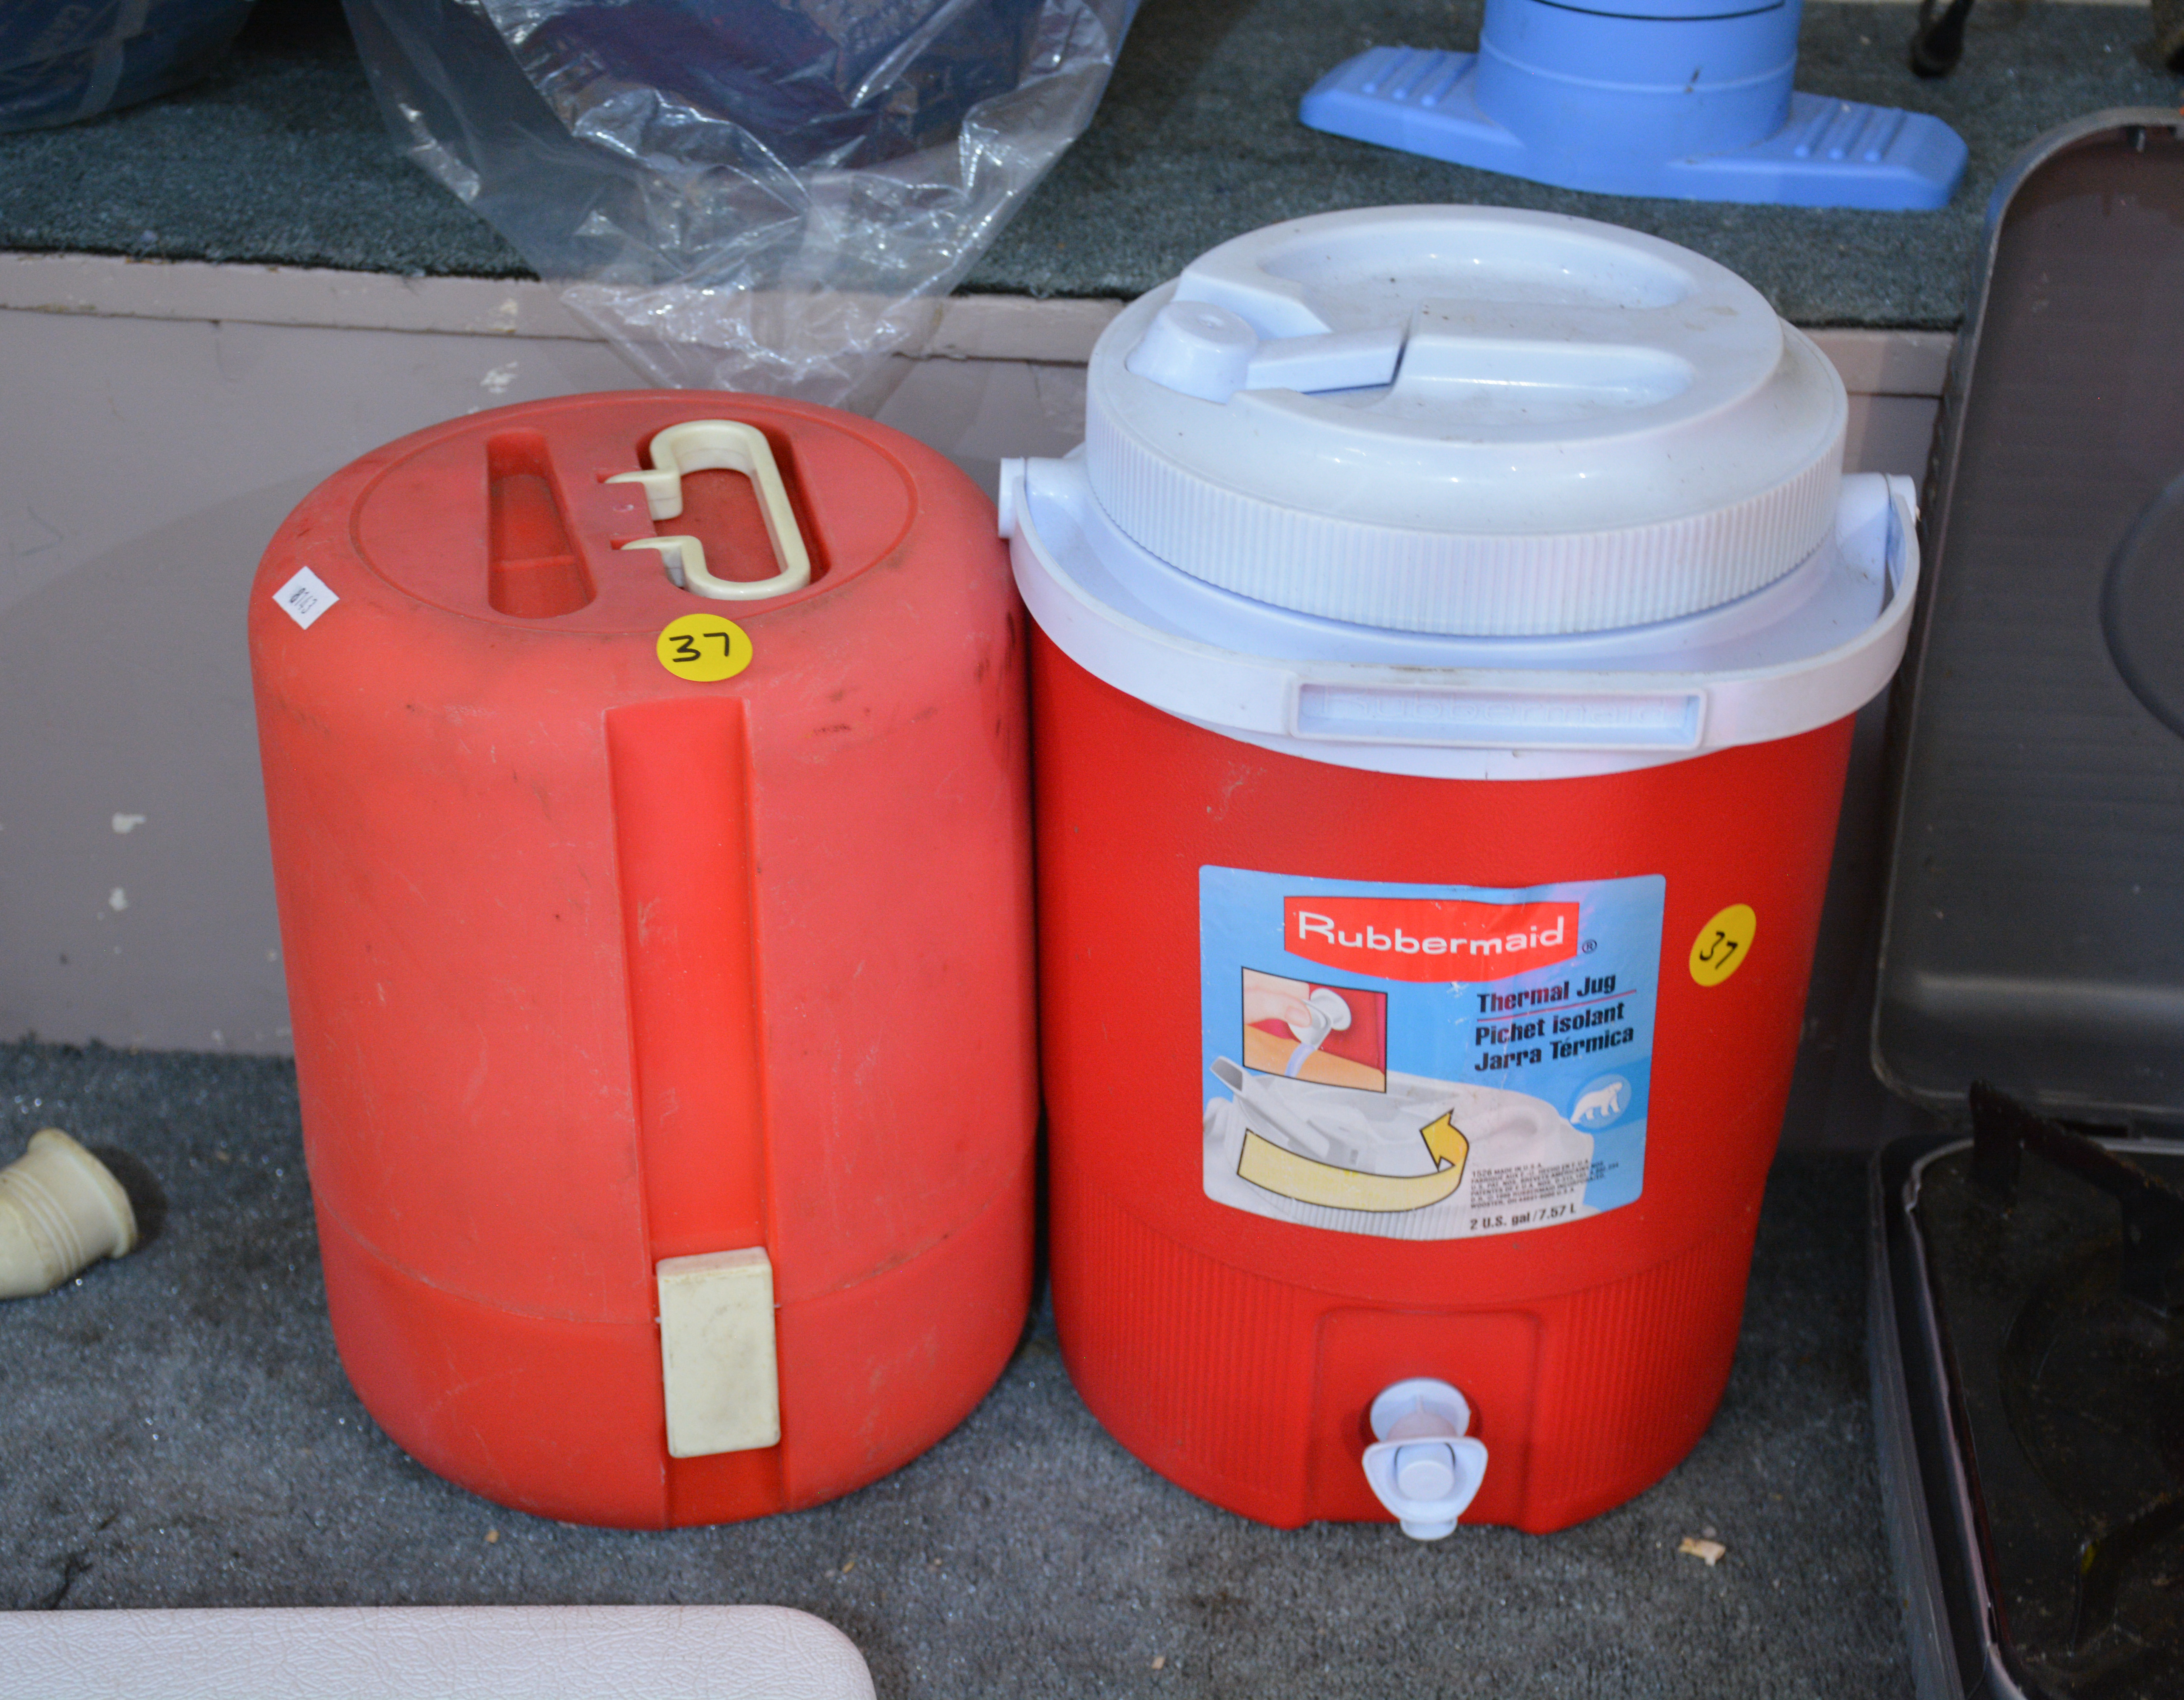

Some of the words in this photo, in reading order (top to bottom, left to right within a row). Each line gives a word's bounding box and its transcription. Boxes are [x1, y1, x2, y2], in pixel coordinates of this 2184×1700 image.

[669, 632, 730, 663] 37
[1299, 910, 1564, 956] Rubbermaid
[1699, 930, 1739, 970] 37
[1477, 980, 1569, 1013] Thermal
[1577, 974, 1616, 997] Jug
[1475, 1018, 1545, 1046] Pichet
[1552, 1001, 1625, 1034] isolant
[1474, 1048, 1542, 1072] Jarra
[1549, 1027, 1634, 1060] Térmica
[1470, 1218, 1478, 1230] 2
[1483, 1216, 1507, 1229] U.S.
[1570, 1203, 1576, 1213] L
